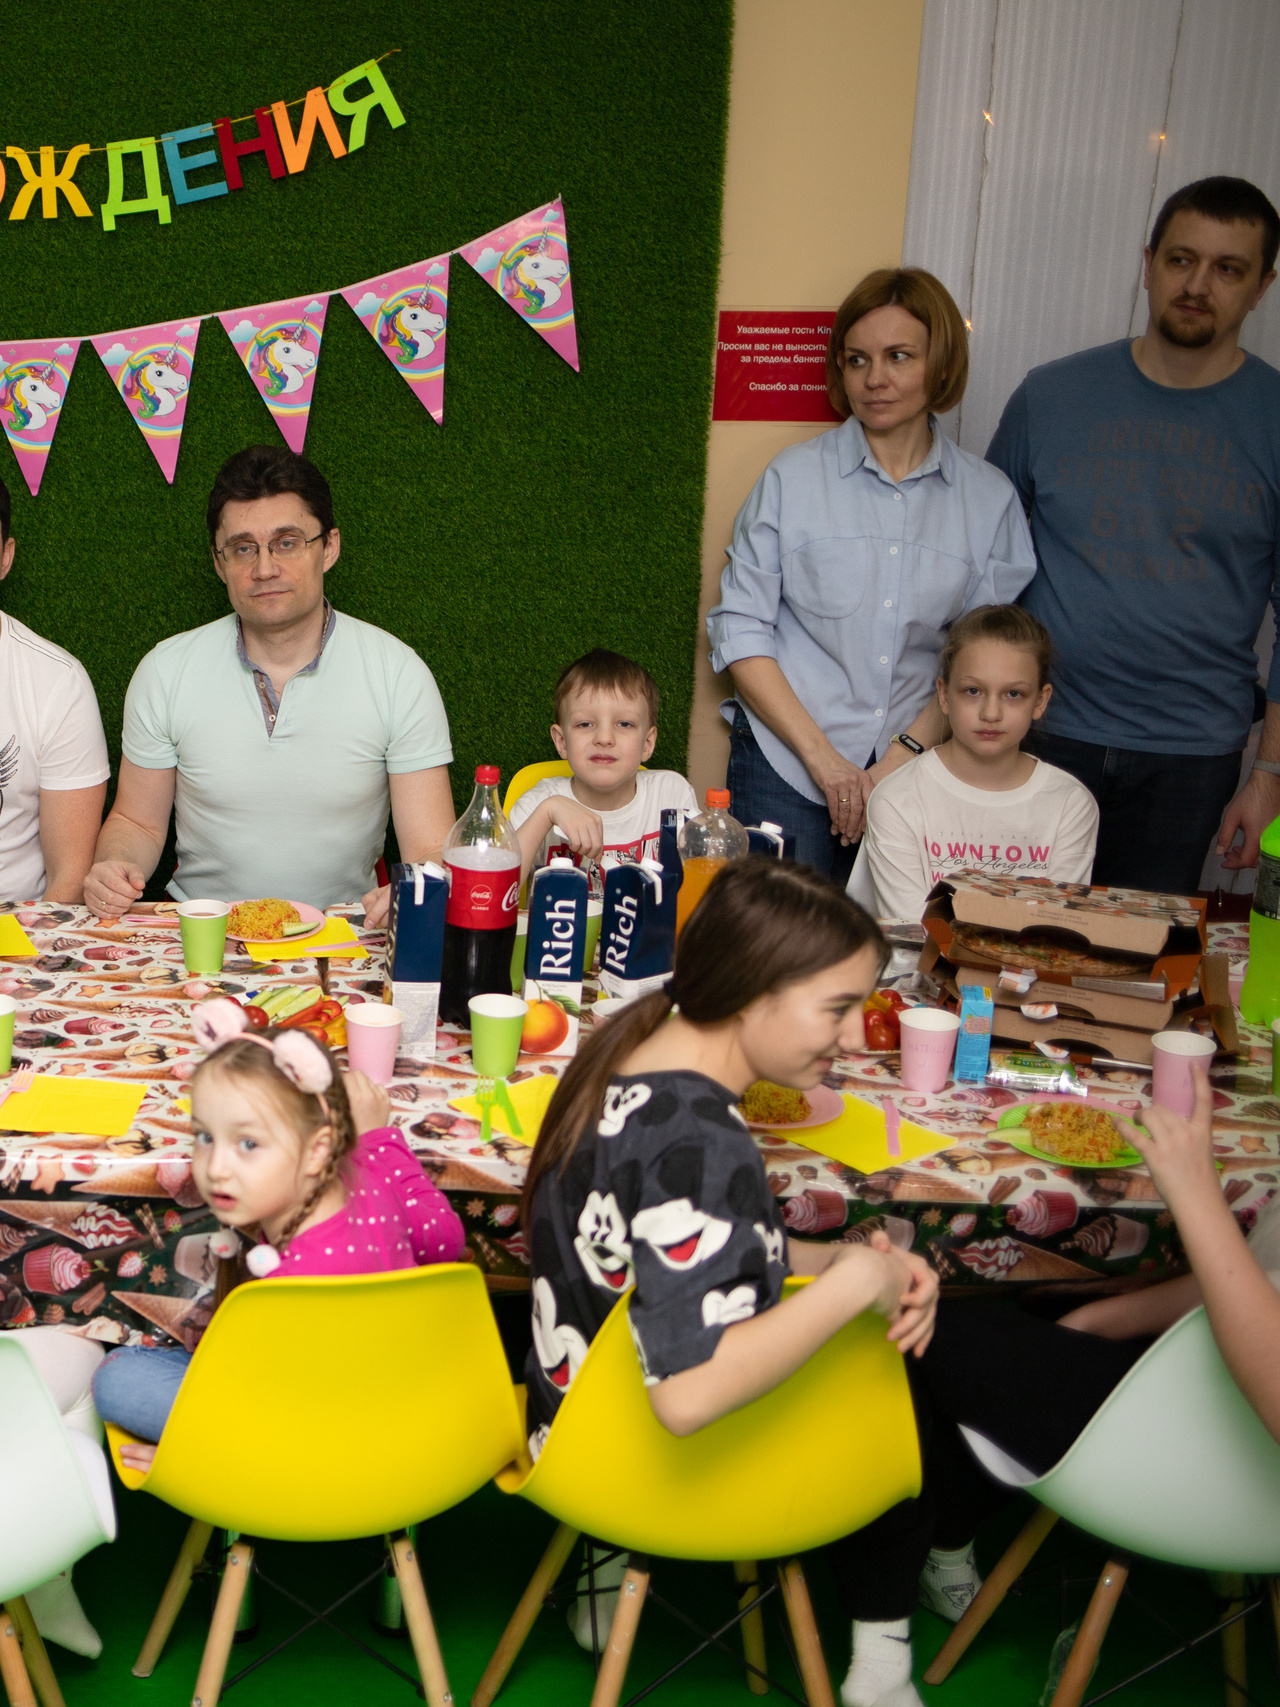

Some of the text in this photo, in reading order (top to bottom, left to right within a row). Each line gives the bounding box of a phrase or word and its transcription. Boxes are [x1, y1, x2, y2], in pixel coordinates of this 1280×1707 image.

[736, 325, 790, 335] Уважаемые
[817, 326, 832, 335] Kin
[717, 342, 752, 351] Просим
[785, 343, 827, 351] выносить
[753, 355, 791, 364] пределы
[749, 382, 787, 391] Спасибо
[788, 383, 799, 391] за
[1088, 420, 1237, 474] ORIGINAL
[1055, 456, 1263, 514] STATE SQUAD
[923, 836, 1050, 863] OWNTOW
[930, 854, 1049, 874] Los Angeles
[540, 899, 577, 977] Rich
[605, 895, 638, 974] Rich
